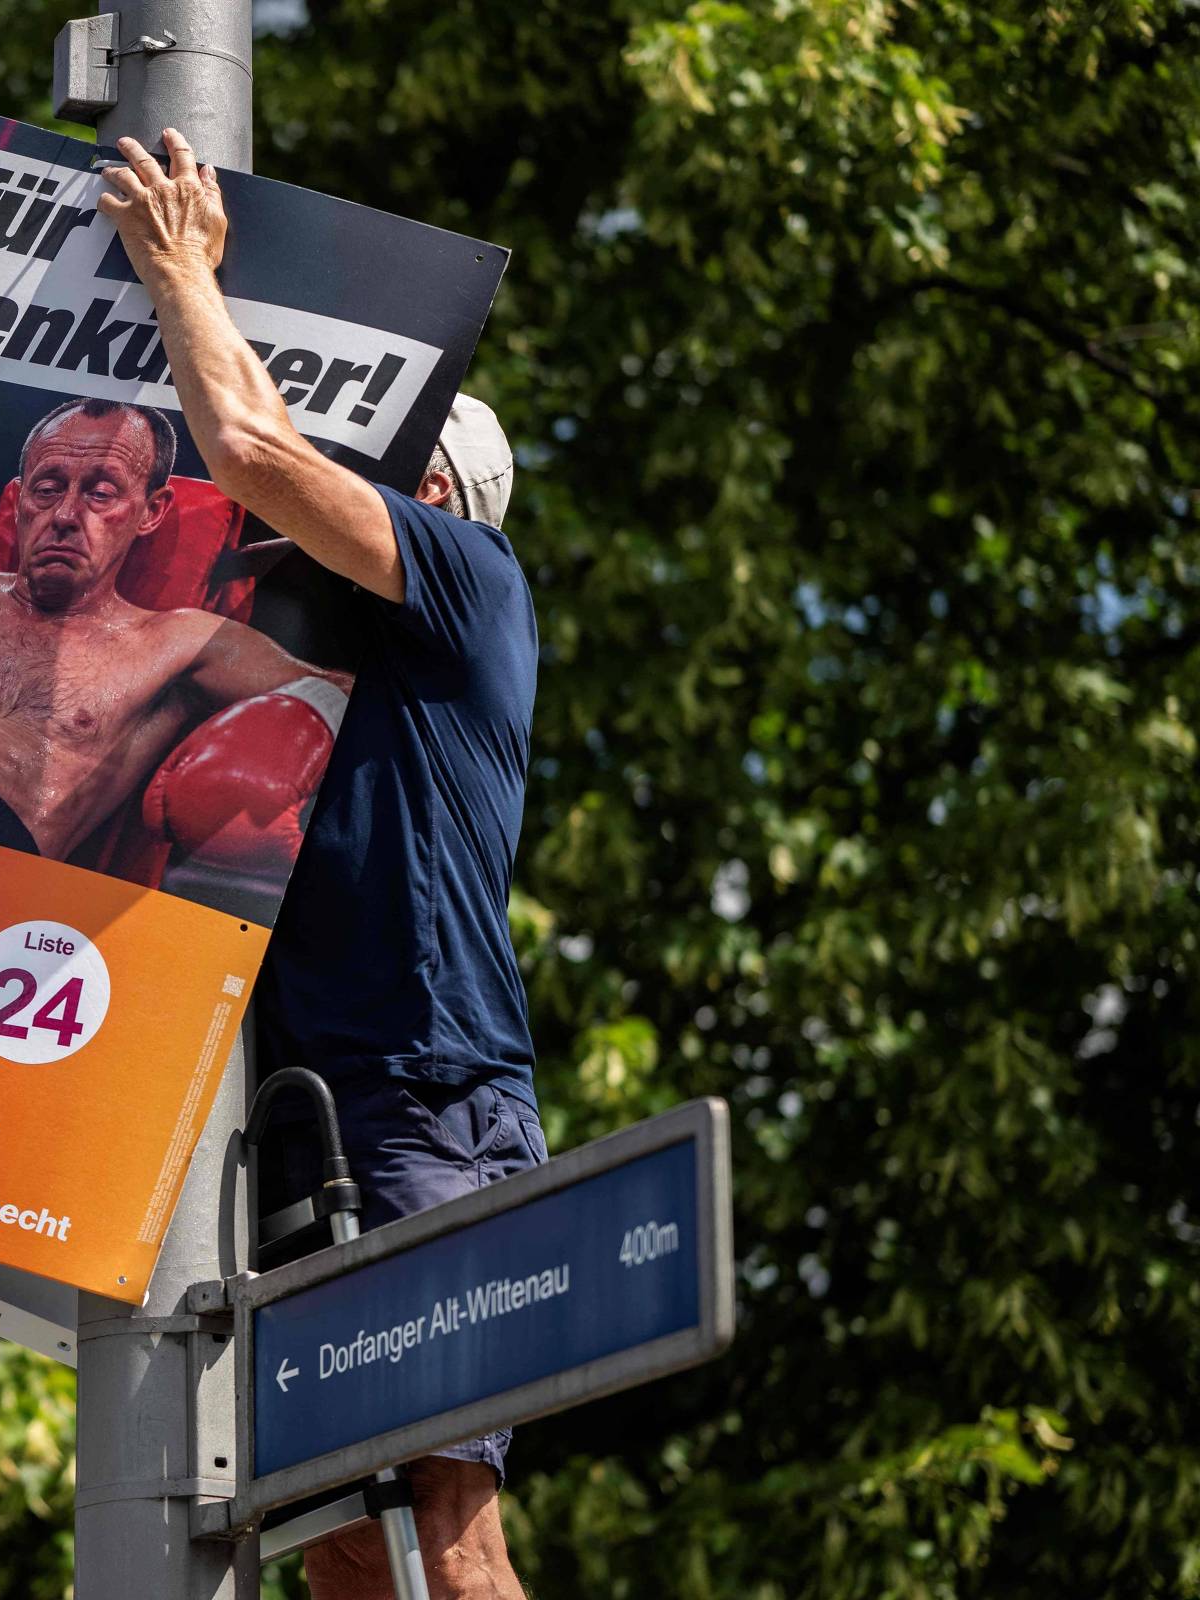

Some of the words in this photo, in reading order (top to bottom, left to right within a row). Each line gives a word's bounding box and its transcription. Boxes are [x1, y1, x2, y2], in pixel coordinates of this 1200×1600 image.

[24, 931, 75, 956] Liste
[319, 1317, 425, 1379] Dorfanger
[430, 1264, 570, 1339] Alt-Wittenau
[619, 1222, 679, 1268] 400m
